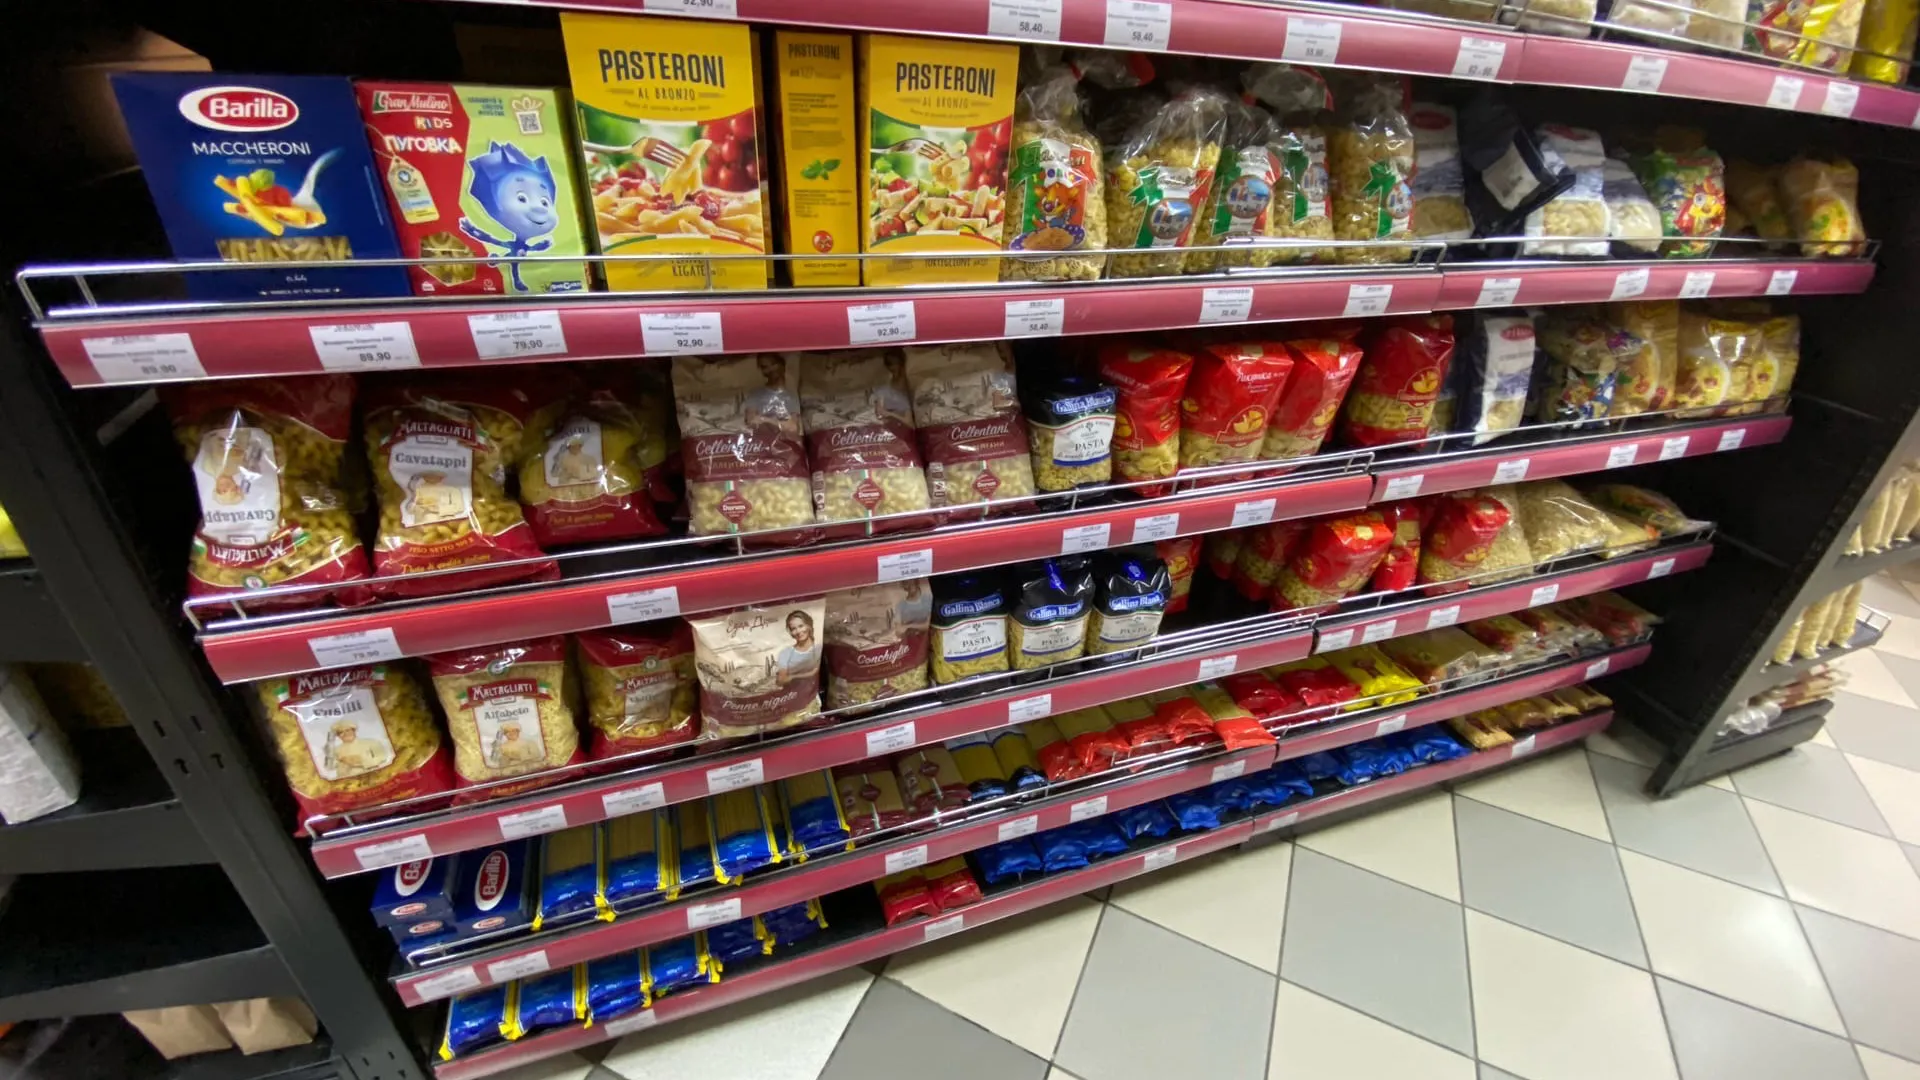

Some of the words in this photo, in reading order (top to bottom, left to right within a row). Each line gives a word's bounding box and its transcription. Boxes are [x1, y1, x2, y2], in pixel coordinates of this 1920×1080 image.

[1019, 21, 1043, 33] 58,40
[788, 43, 840, 60] PASTERONI
[598, 49, 725, 88] PASTERONI
[896, 62, 996, 98] PASTERONI
[377, 92, 407, 110] Gran
[406, 93, 448, 111] Mulino
[637, 88, 649, 99] AL
[656, 88, 696, 101] BRONZO
[209, 97, 288, 118] Barilla
[414, 116, 452, 129] KIDS
[192, 141, 311, 155] MACCHERONI
[384, 136, 463, 153] ПУГОВКА
[514, 339, 543, 350] 79,90
[677, 338, 703, 348] 92,90
[1056, 400, 1085, 413] Gallina
[951, 422, 1009, 440] Cellentani
[1075, 438, 1104, 451] PASTA
[395, 452, 467, 469] Cavatappi
[944, 604, 975, 615] Gallina
[975, 598, 1001, 611] Blanca
[1030, 608, 1057, 619] Gallina
[962, 636, 991, 648] PASTA
[857, 644, 910, 666] Conchiglie
[472, 682, 533, 700] MALTAGLIATI
[484, 706, 529, 721] Alfabeto
[722, 700, 759, 711] Penne
[482, 855, 502, 896] Barilla
